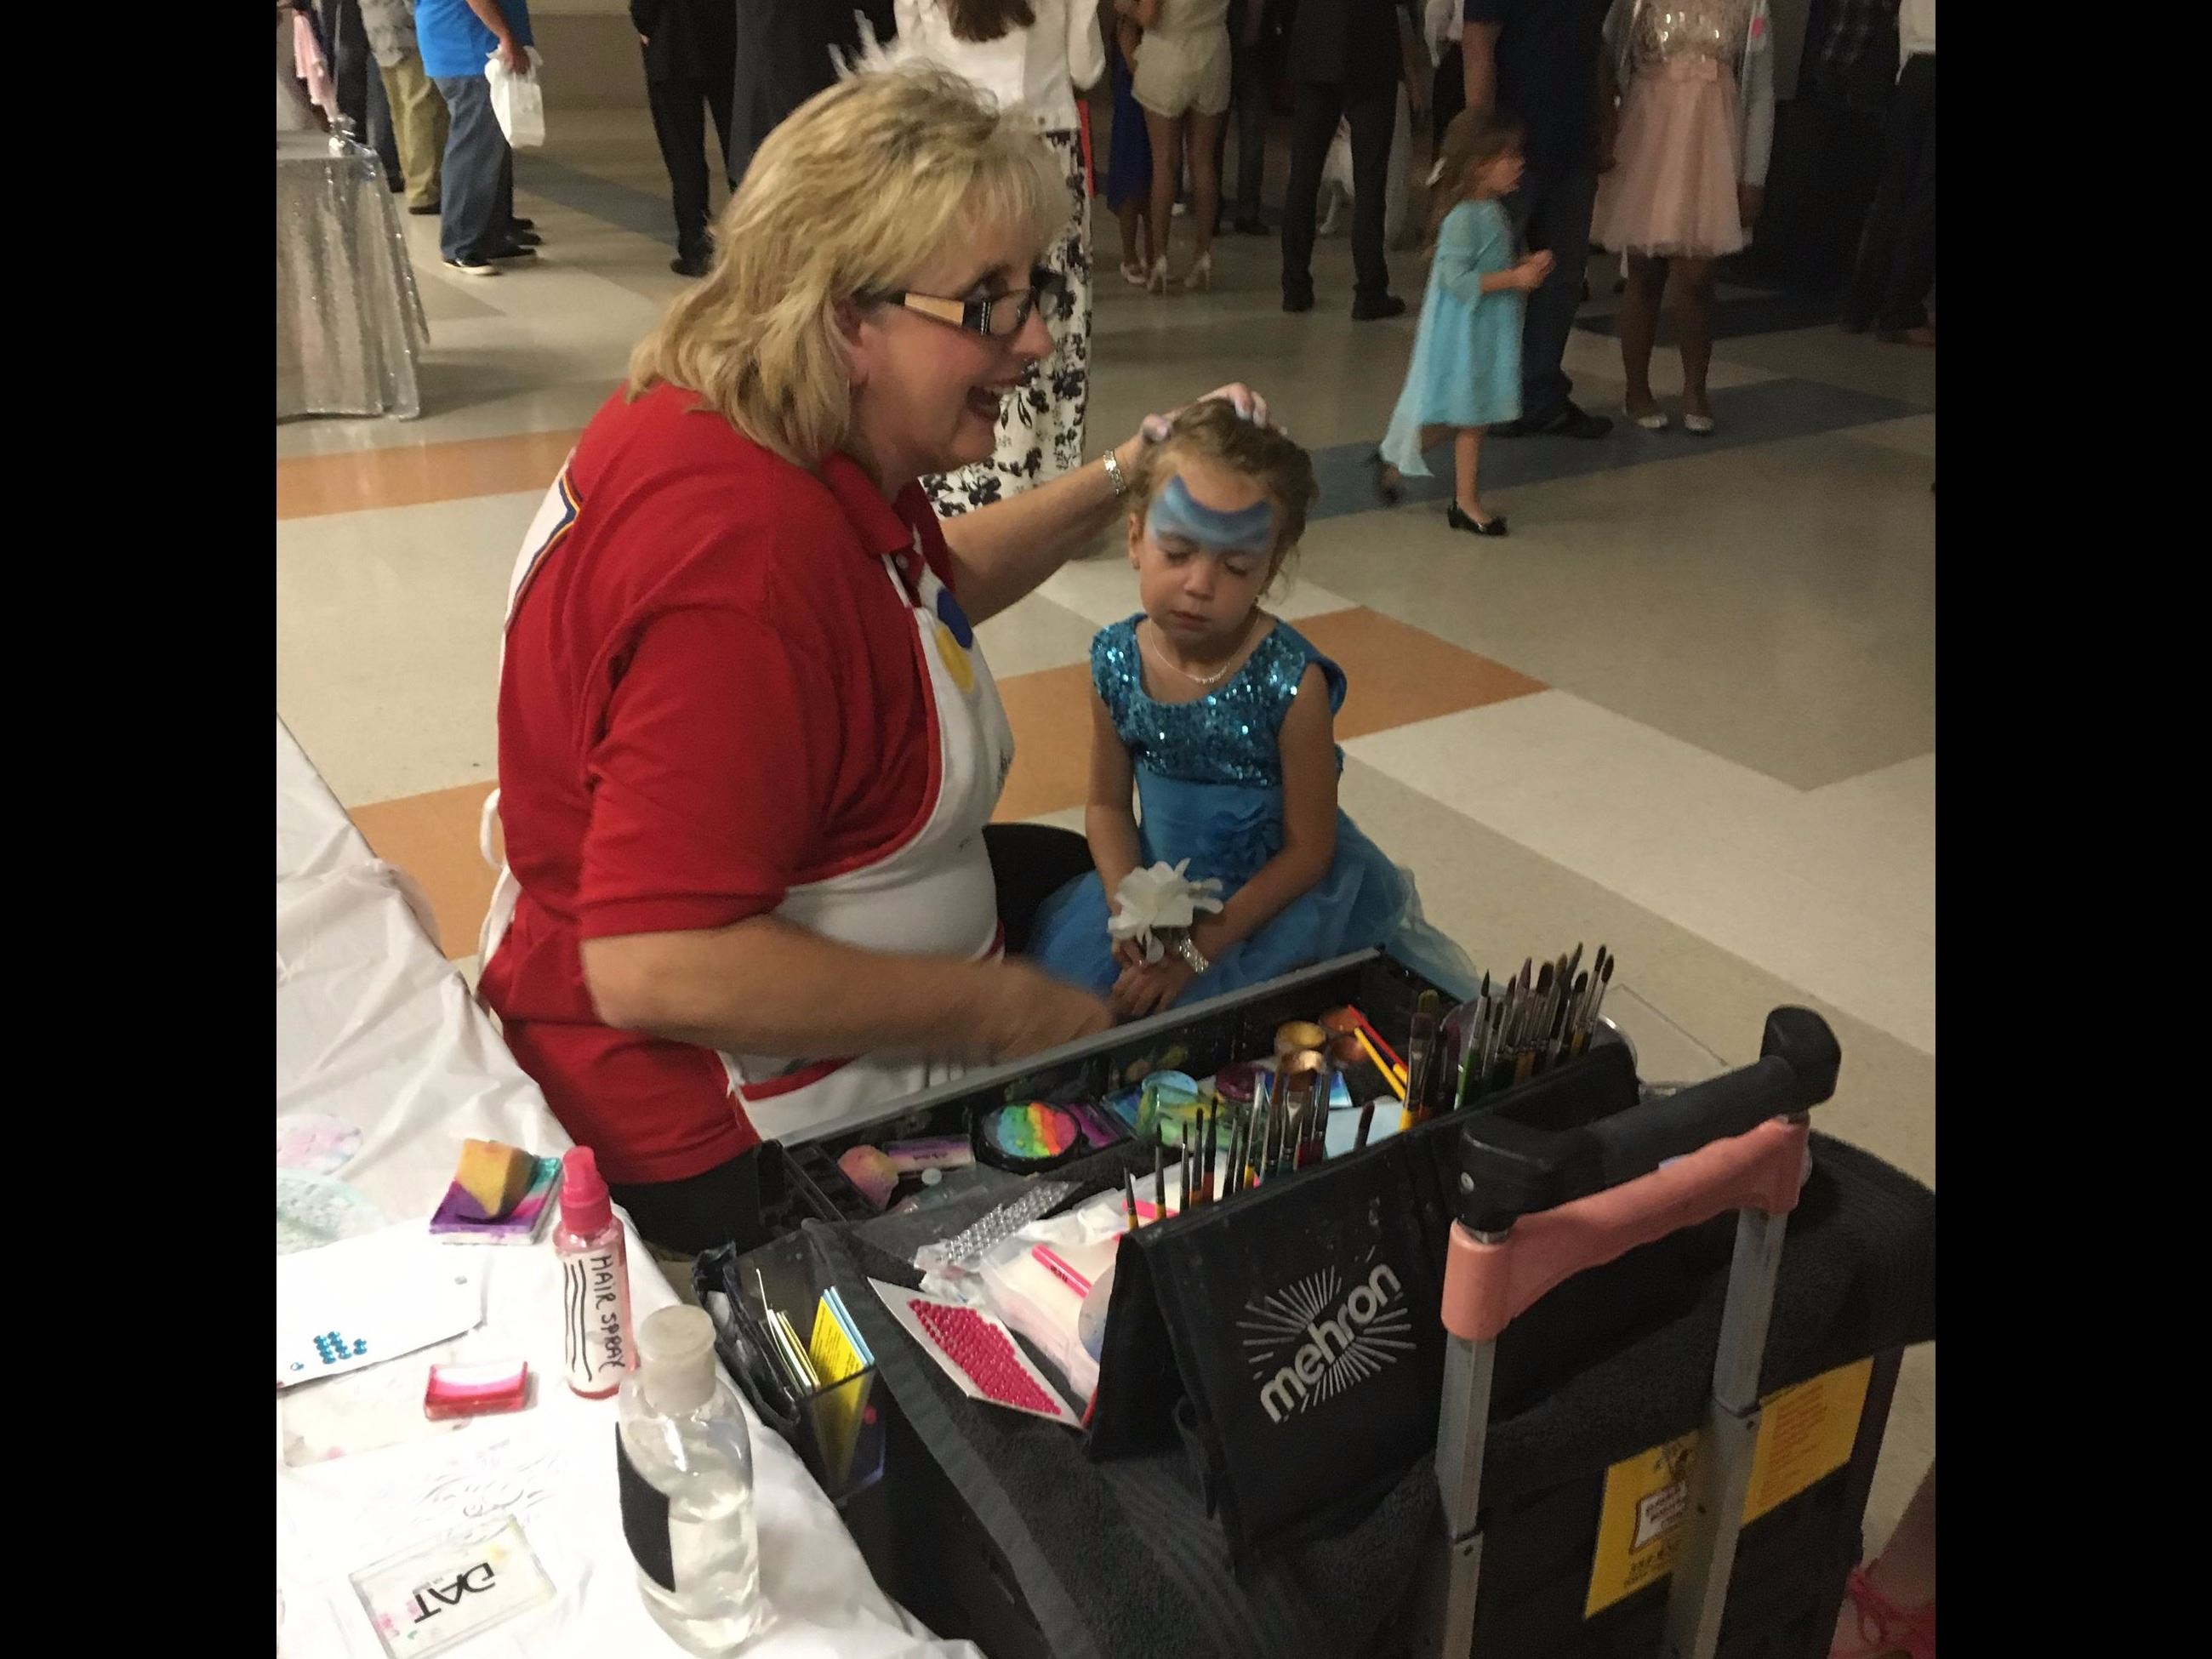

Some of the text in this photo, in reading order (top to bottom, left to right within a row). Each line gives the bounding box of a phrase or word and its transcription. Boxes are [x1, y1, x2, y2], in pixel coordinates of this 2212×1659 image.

[590, 1254, 625, 1372] HAIR SPRAY
[1260, 1263, 1402, 1423] mehron
[413, 1562, 495, 1623] DAT
